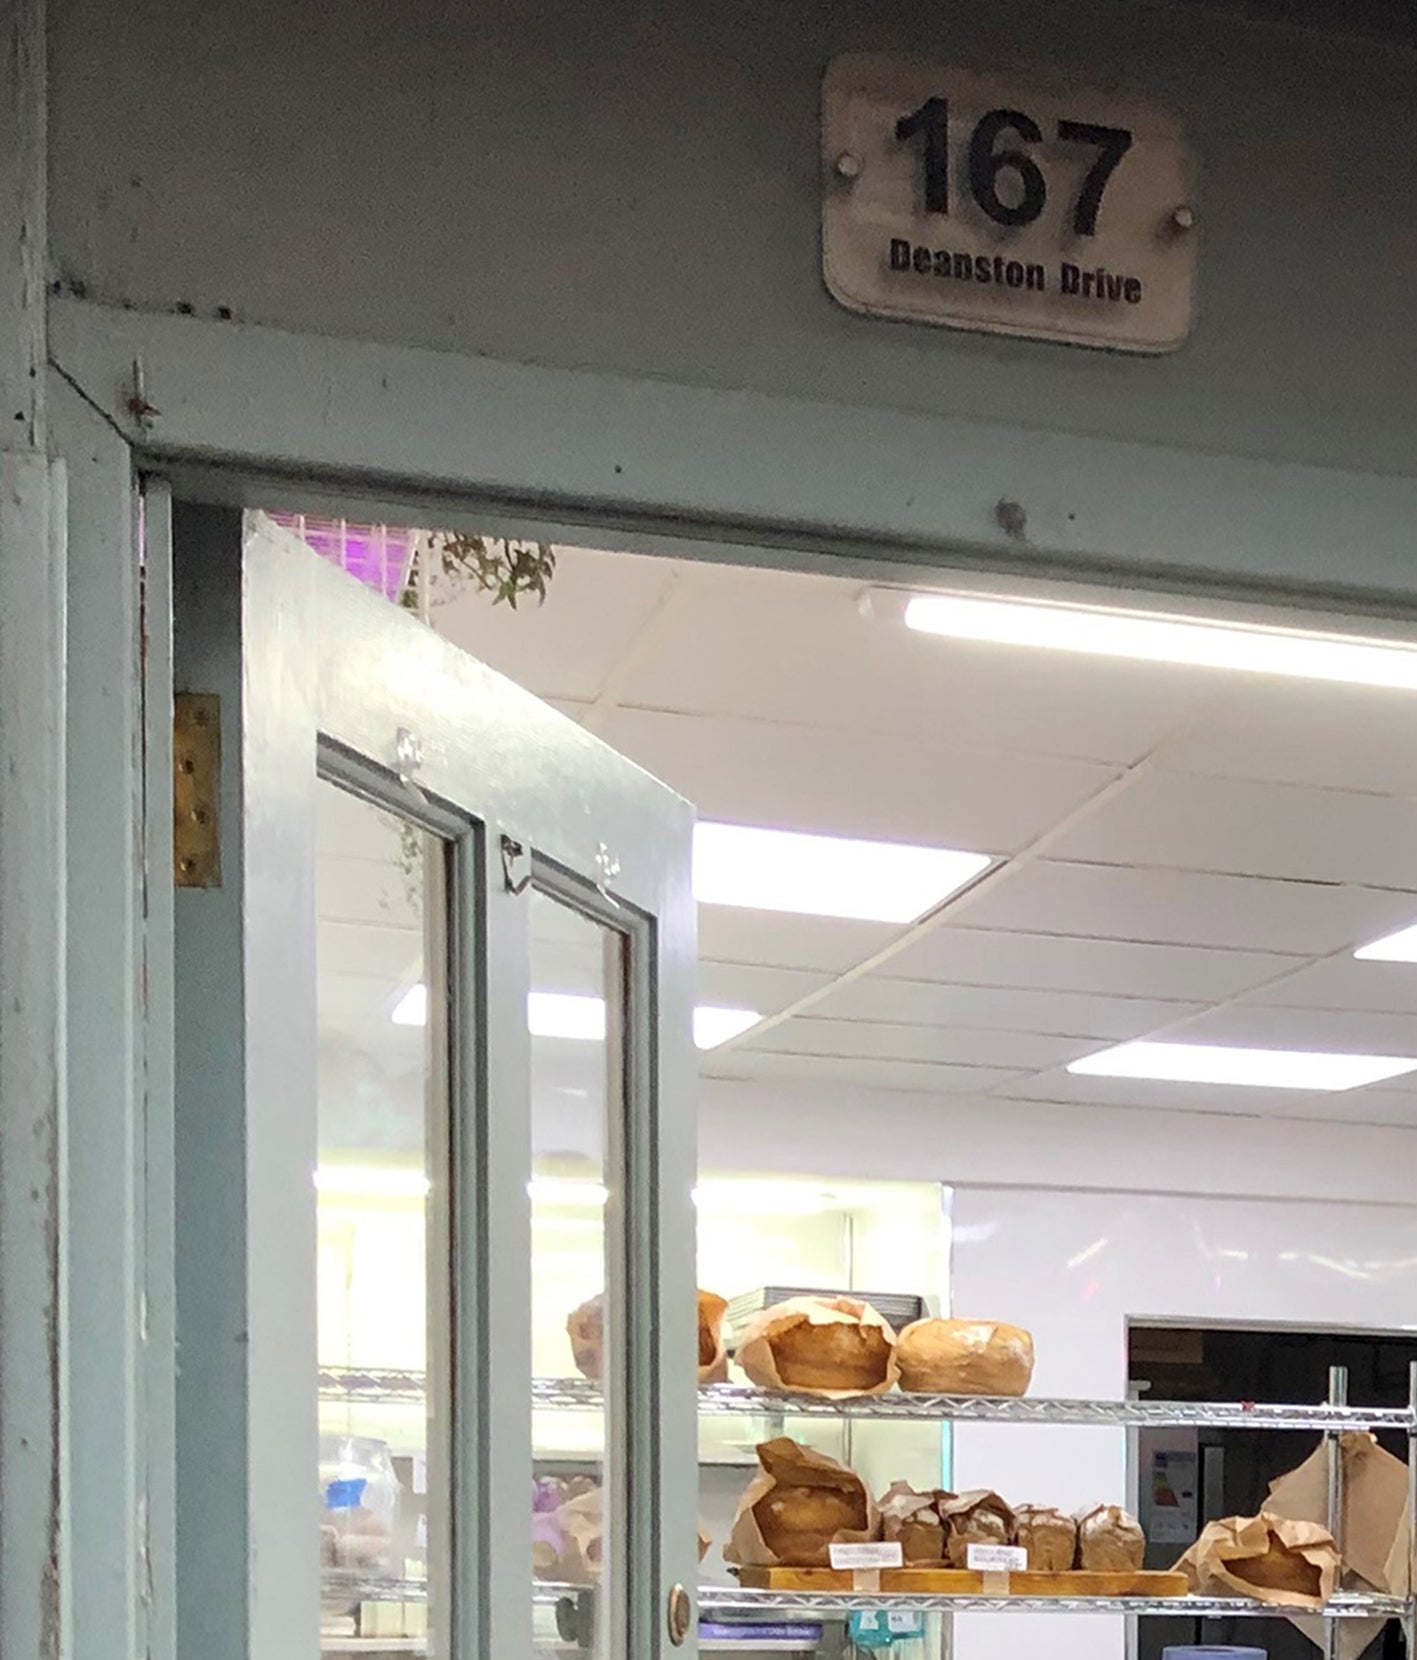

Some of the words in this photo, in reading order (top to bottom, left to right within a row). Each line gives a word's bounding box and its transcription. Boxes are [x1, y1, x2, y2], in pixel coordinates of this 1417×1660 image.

[895, 96, 1133, 237] 167
[890, 238, 1045, 292] Deanston
[1060, 261, 1142, 304] Drive
